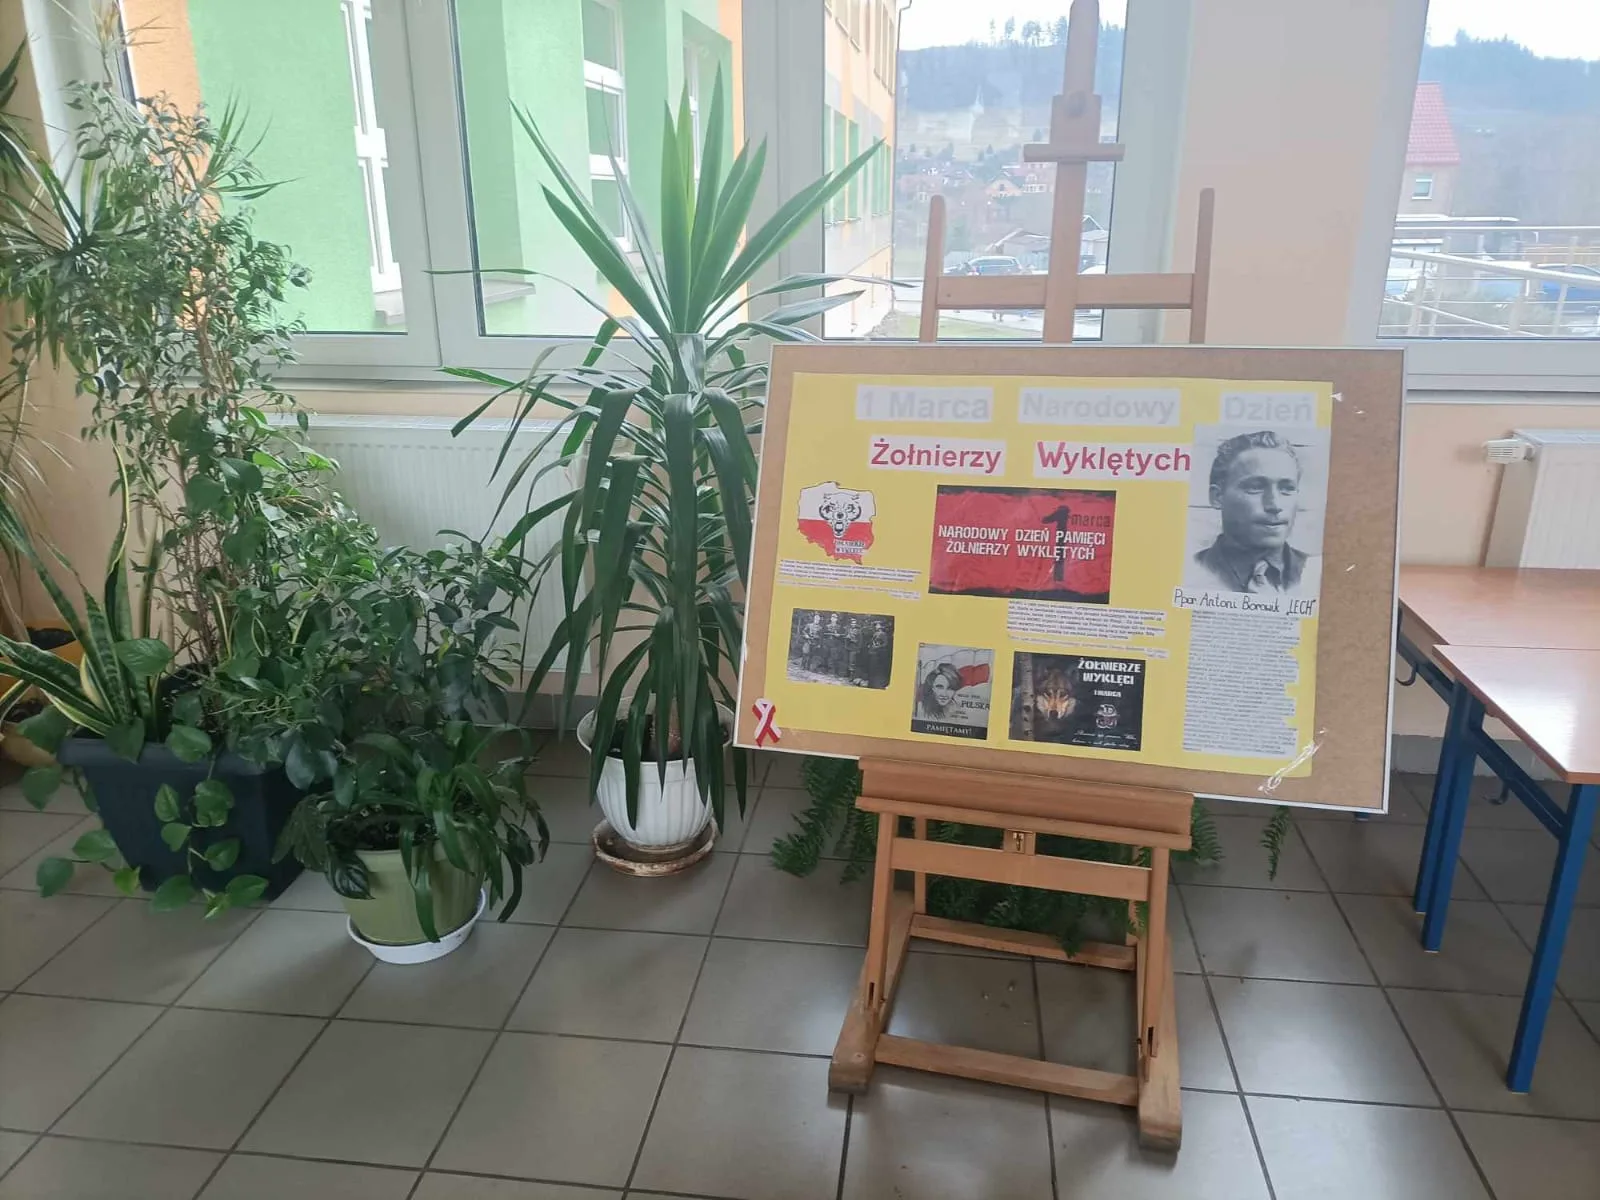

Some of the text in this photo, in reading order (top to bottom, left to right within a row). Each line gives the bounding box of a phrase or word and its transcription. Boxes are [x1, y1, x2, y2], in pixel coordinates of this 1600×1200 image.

[861, 391, 1313, 425] 1 Marca Narodowy Dzień
[871, 437, 1191, 475] Żołnierzy Wyklętych
[1071, 514, 1111, 528] marca
[938, 525, 1106, 548] NARODOWY DZIEŃ PAMIĘCI
[945, 539, 1095, 561] ŻOŁNIERZY WYKLĘTYCH
[1200, 592, 1238, 609] Antoni
[1077, 657, 1141, 673] ŻOŁNIERZE
